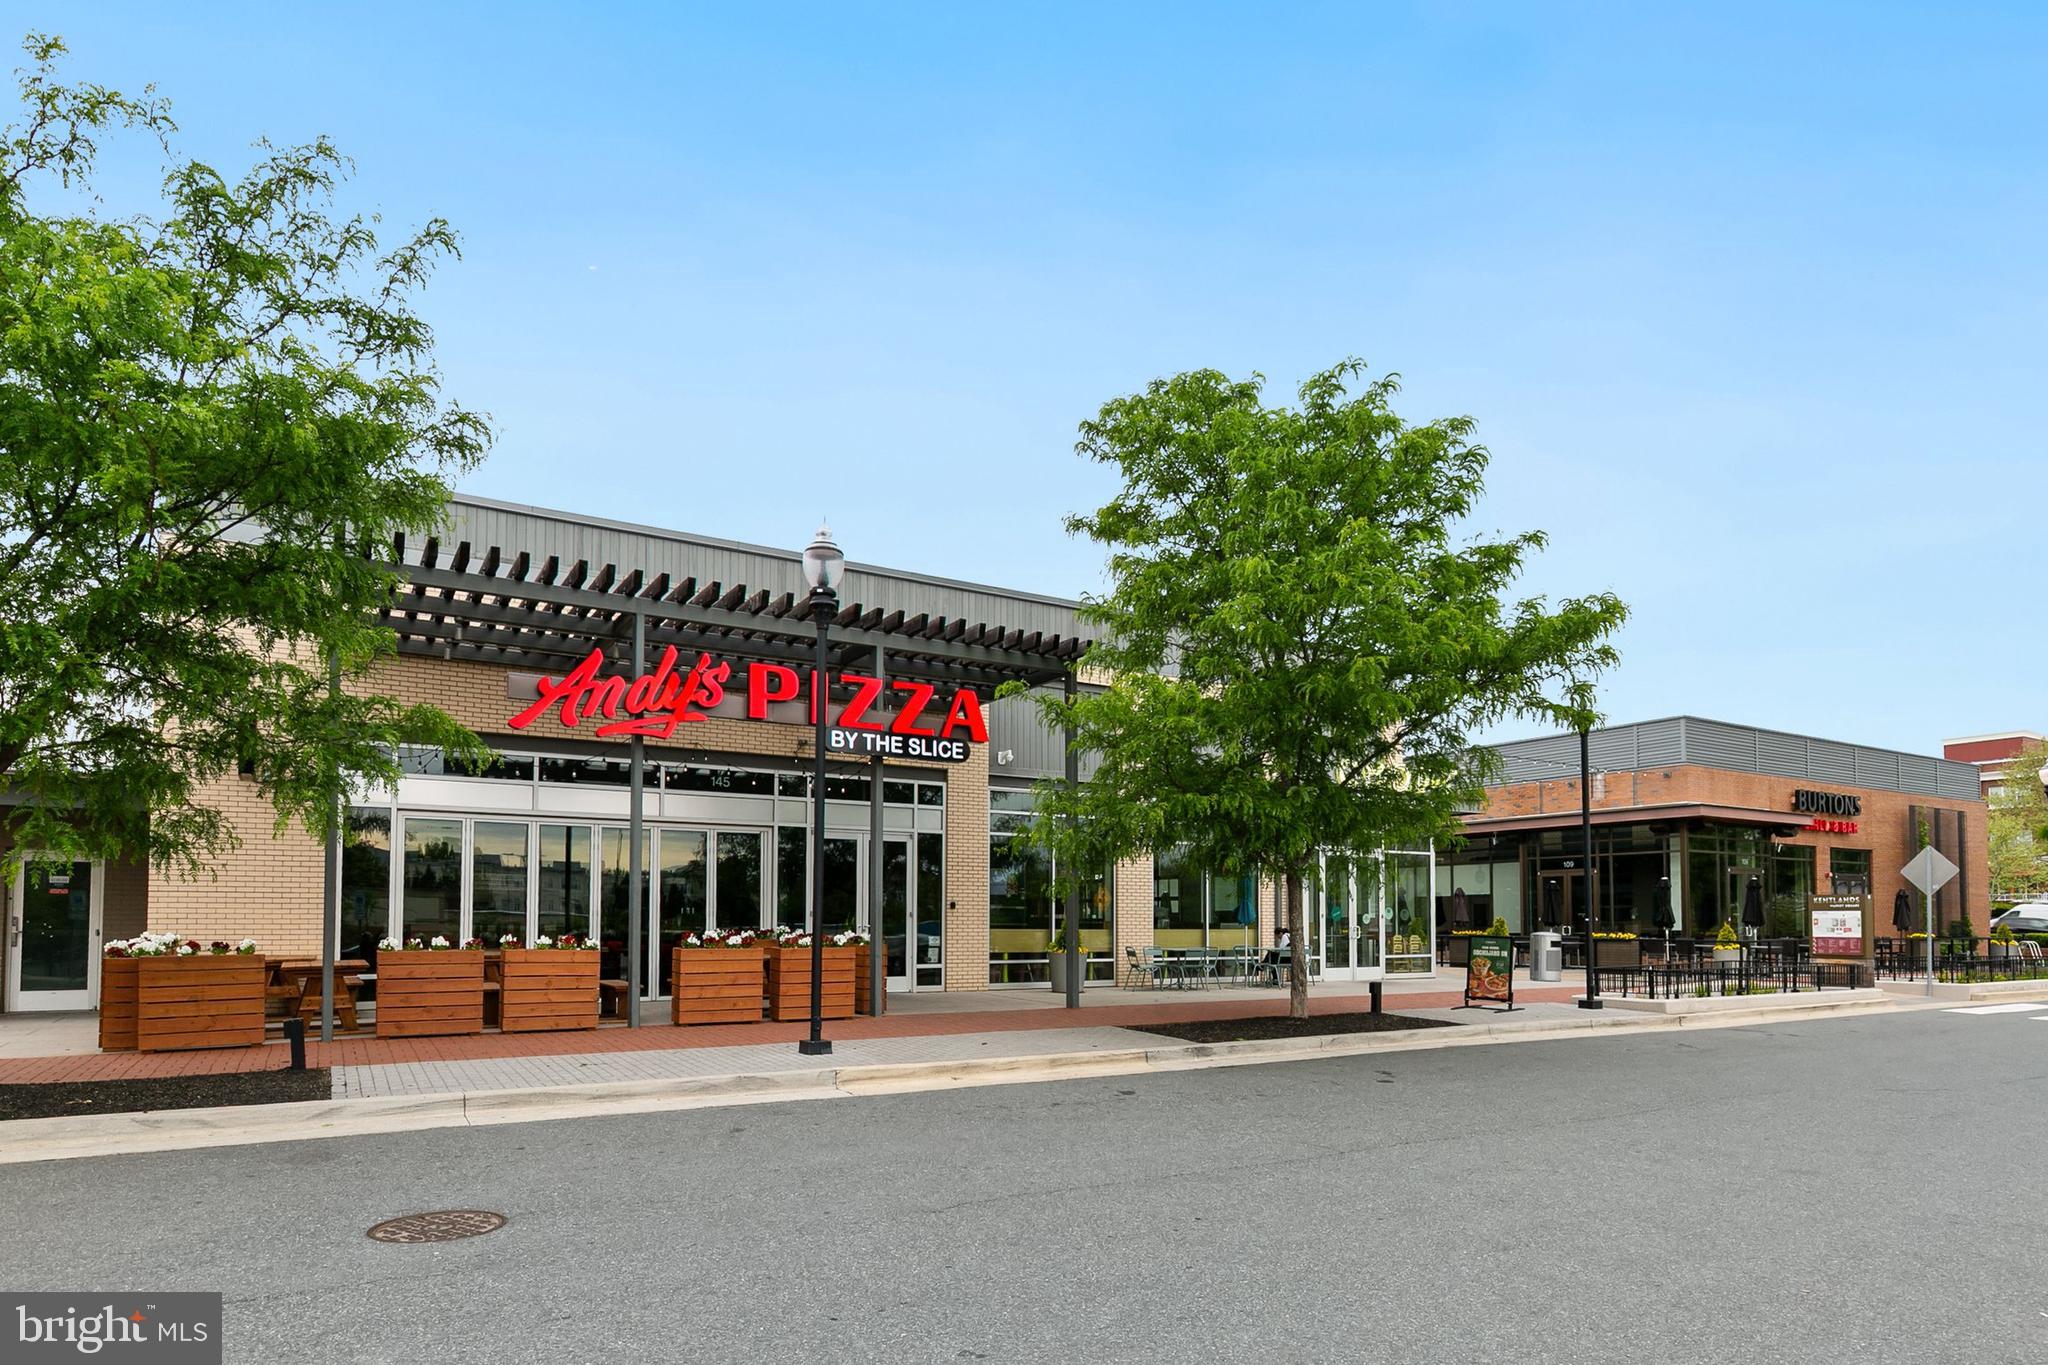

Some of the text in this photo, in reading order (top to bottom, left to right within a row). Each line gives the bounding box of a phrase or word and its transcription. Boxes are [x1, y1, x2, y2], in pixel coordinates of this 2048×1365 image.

[507, 644, 731, 740] Andy's
[830, 730, 965, 760] BY THE SLICE
[710, 776, 731, 788] 145
[1563, 860, 1575, 868] 109
